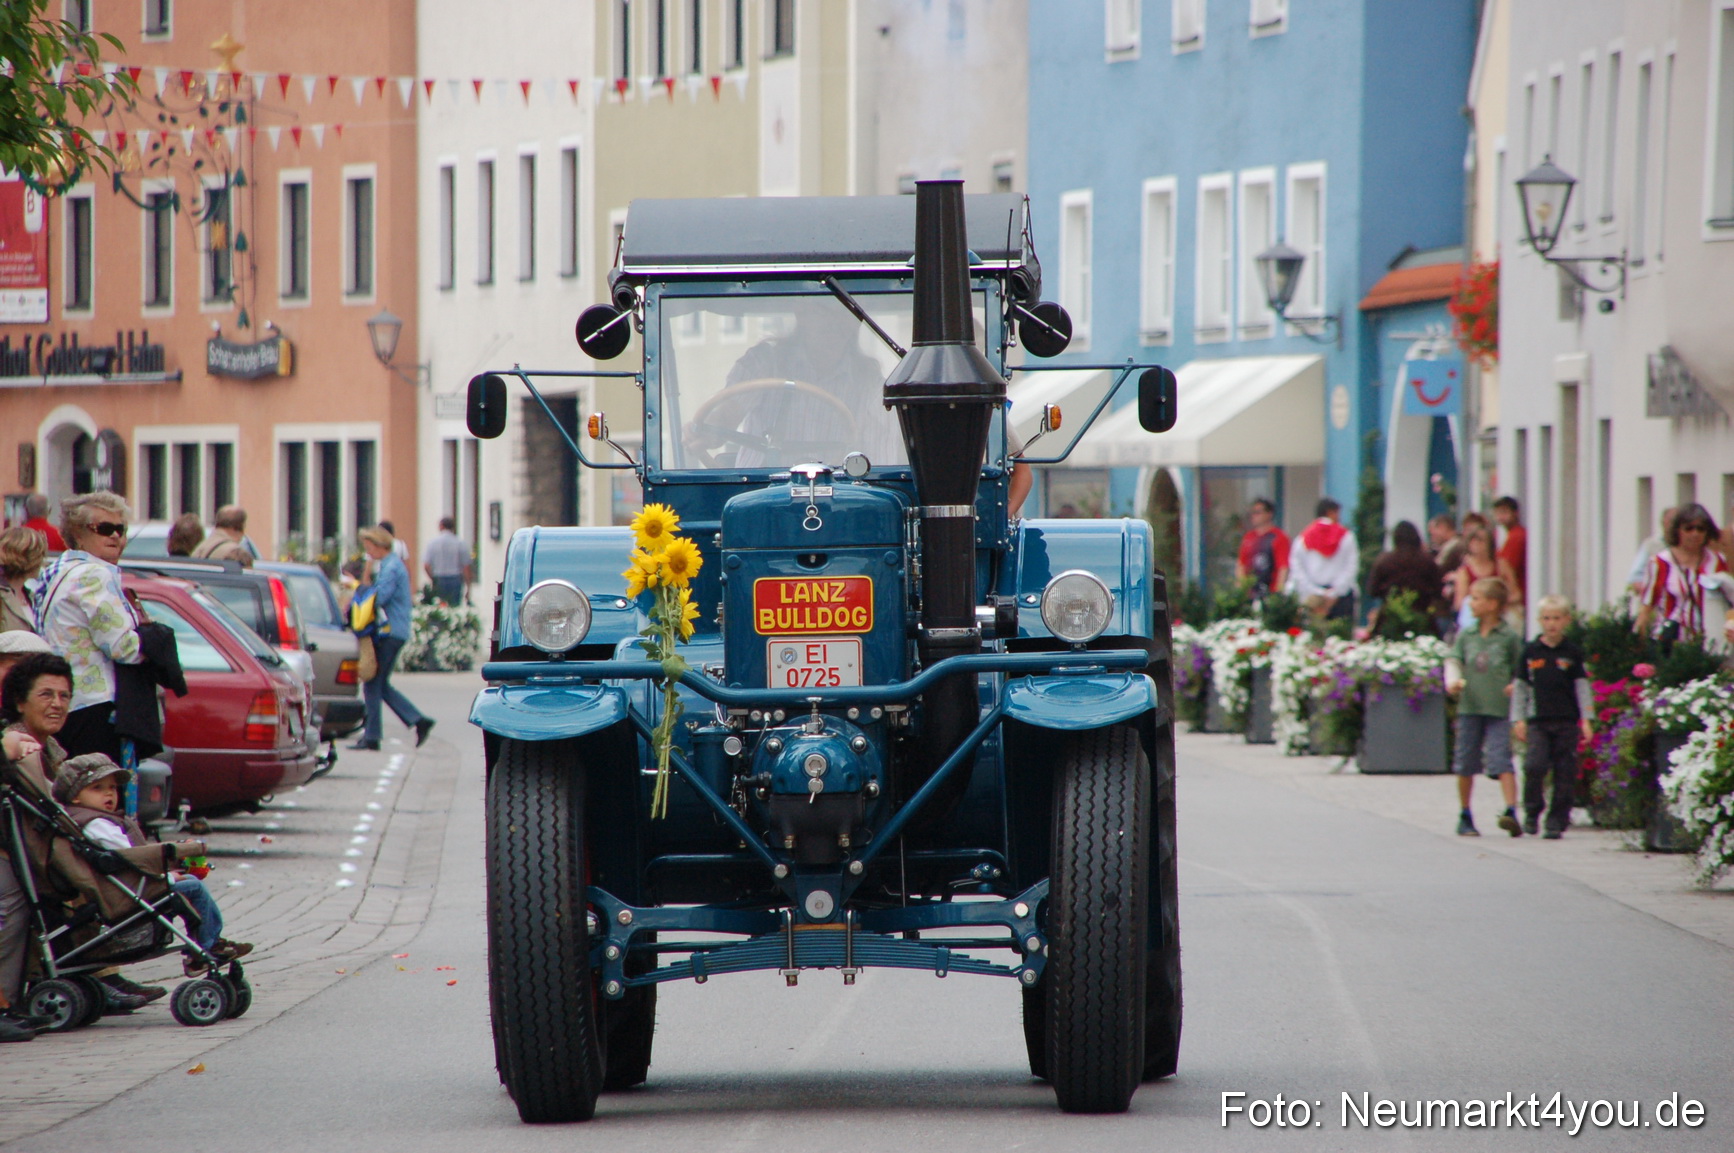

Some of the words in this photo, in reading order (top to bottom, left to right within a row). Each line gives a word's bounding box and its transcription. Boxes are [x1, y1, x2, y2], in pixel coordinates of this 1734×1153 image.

[780, 582, 846, 604] LANZ
[759, 606, 867, 630] BULLDOG
[806, 644, 827, 664] EI
[786, 667, 841, 688] 0725
